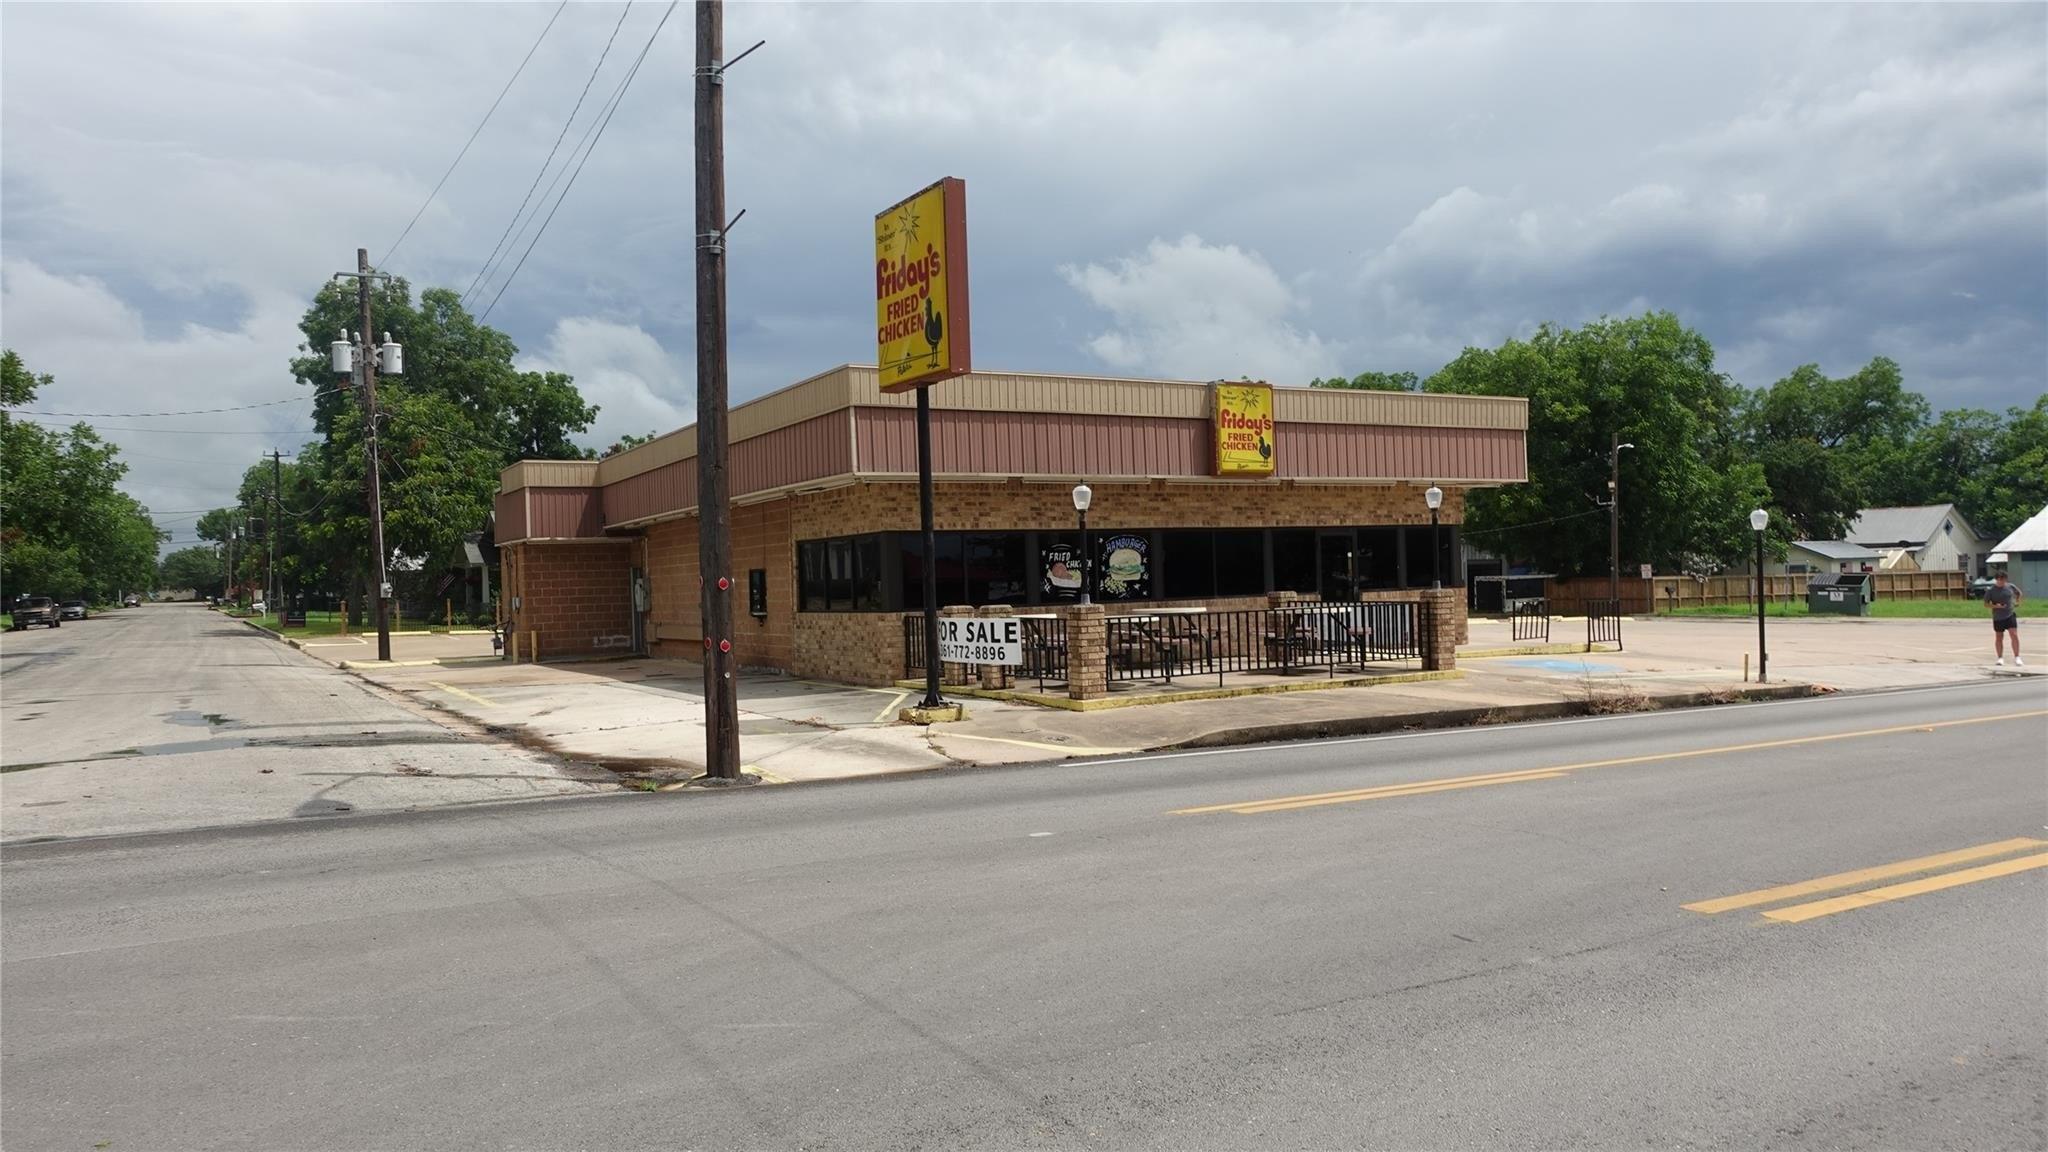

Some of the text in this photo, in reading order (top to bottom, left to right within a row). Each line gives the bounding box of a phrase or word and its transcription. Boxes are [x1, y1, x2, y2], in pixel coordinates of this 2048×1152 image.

[887, 293, 919, 322] FRIED
[878, 312, 925, 345] CHICKEN
[1228, 433, 1253, 442] FRIED
[1221, 442, 1258, 451] CHICKEN
[1106, 538, 1146, 553] HAMBURGER
[1049, 552, 1071, 562] FRIED
[966, 621, 1018, 643] SALE
